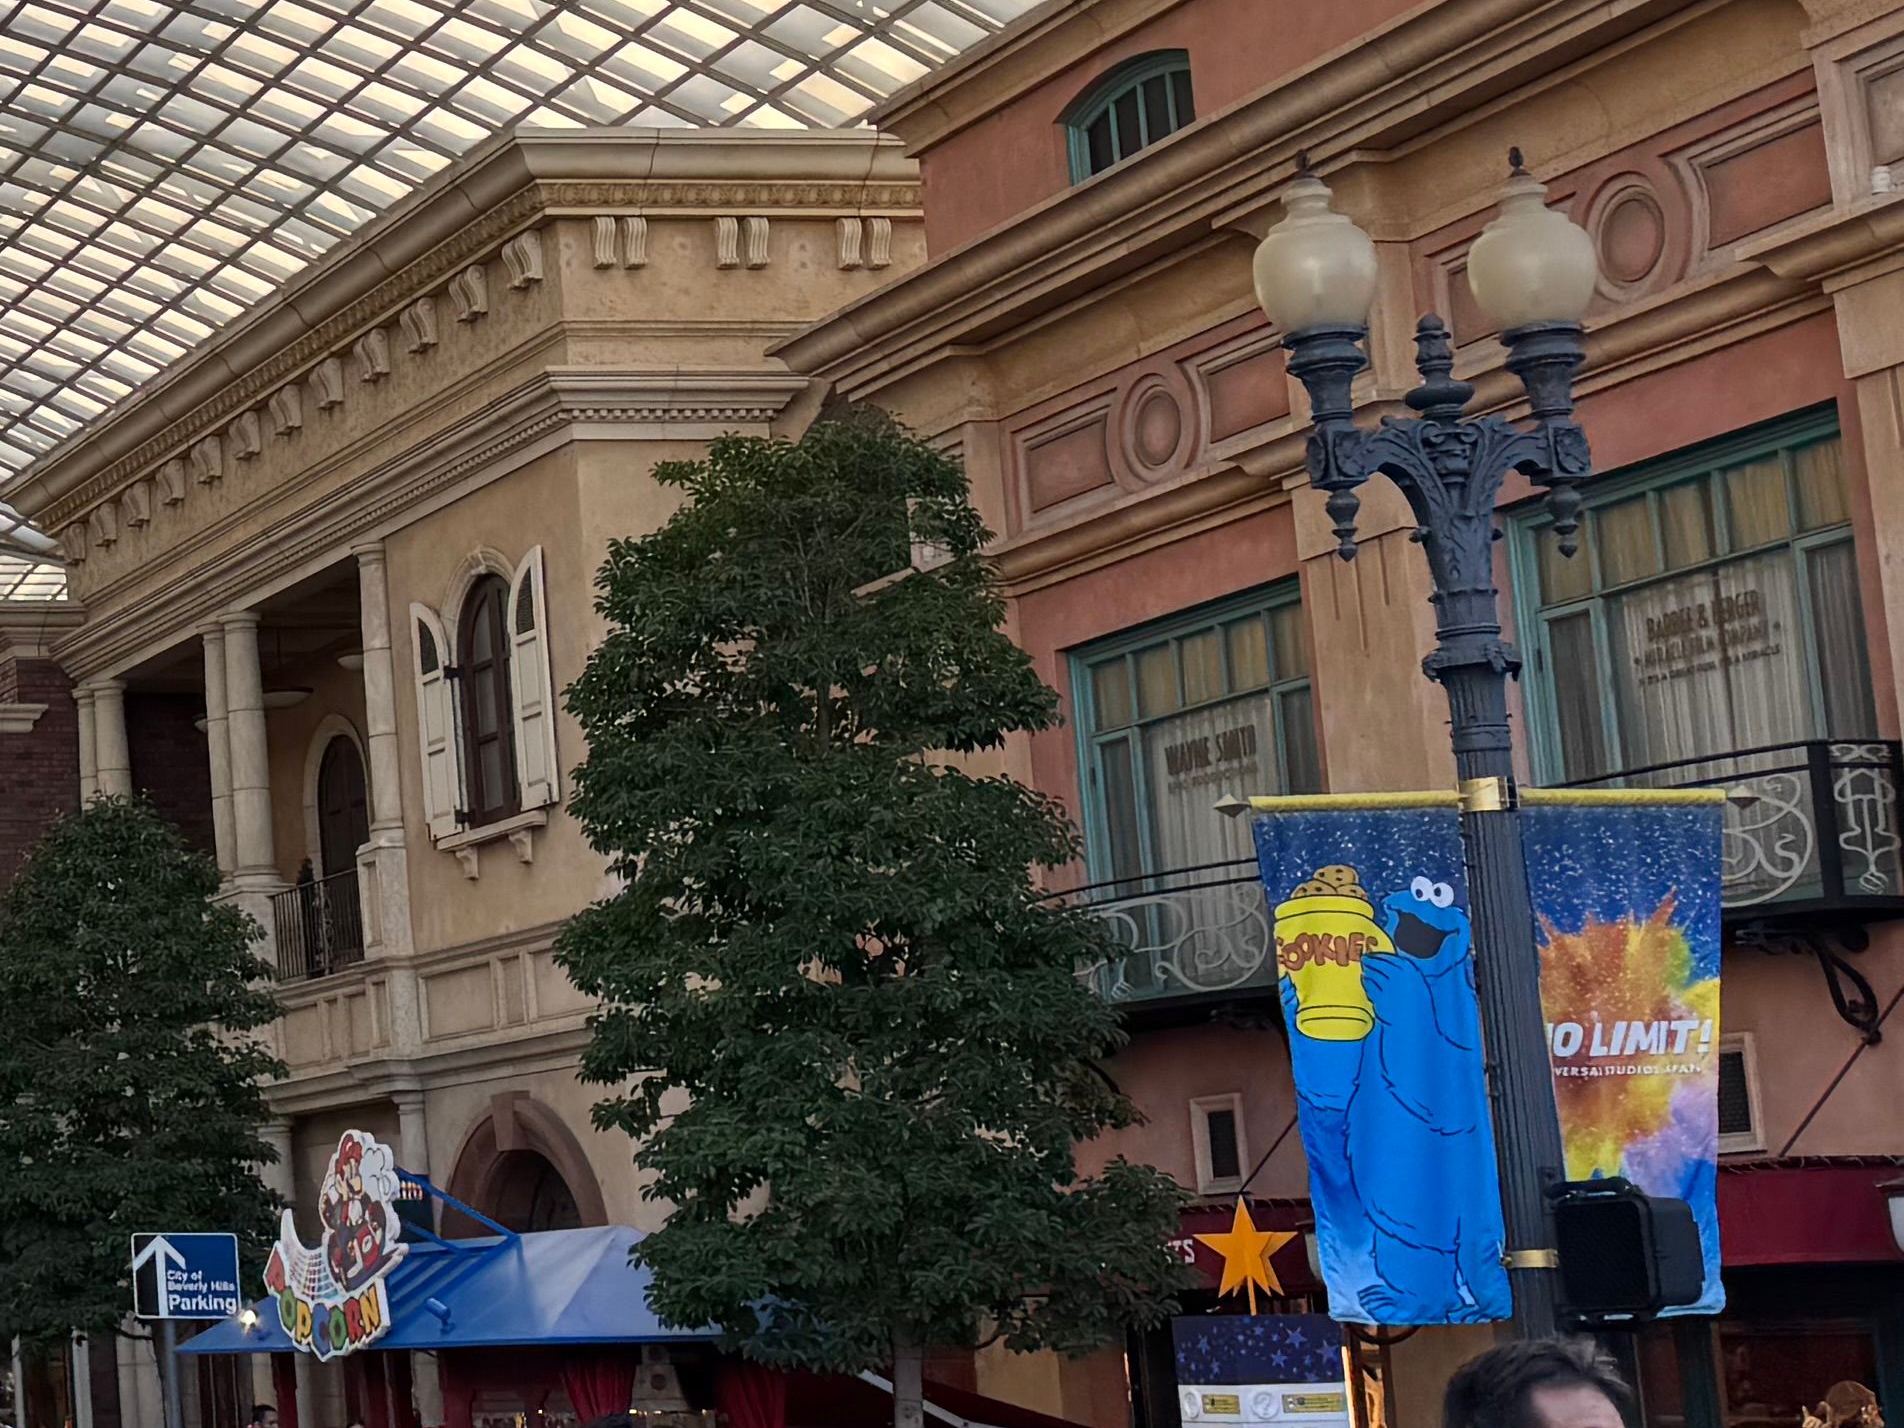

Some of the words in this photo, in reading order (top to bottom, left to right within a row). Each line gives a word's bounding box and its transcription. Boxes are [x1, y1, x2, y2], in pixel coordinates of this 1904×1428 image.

[1589, 1019, 1713, 1057] LIMIT!
[167, 1270, 189, 1285] City
[190, 1270, 203, 1281] of
[167, 1280, 208, 1294] Beverly
[168, 1294, 238, 1315] Parking
